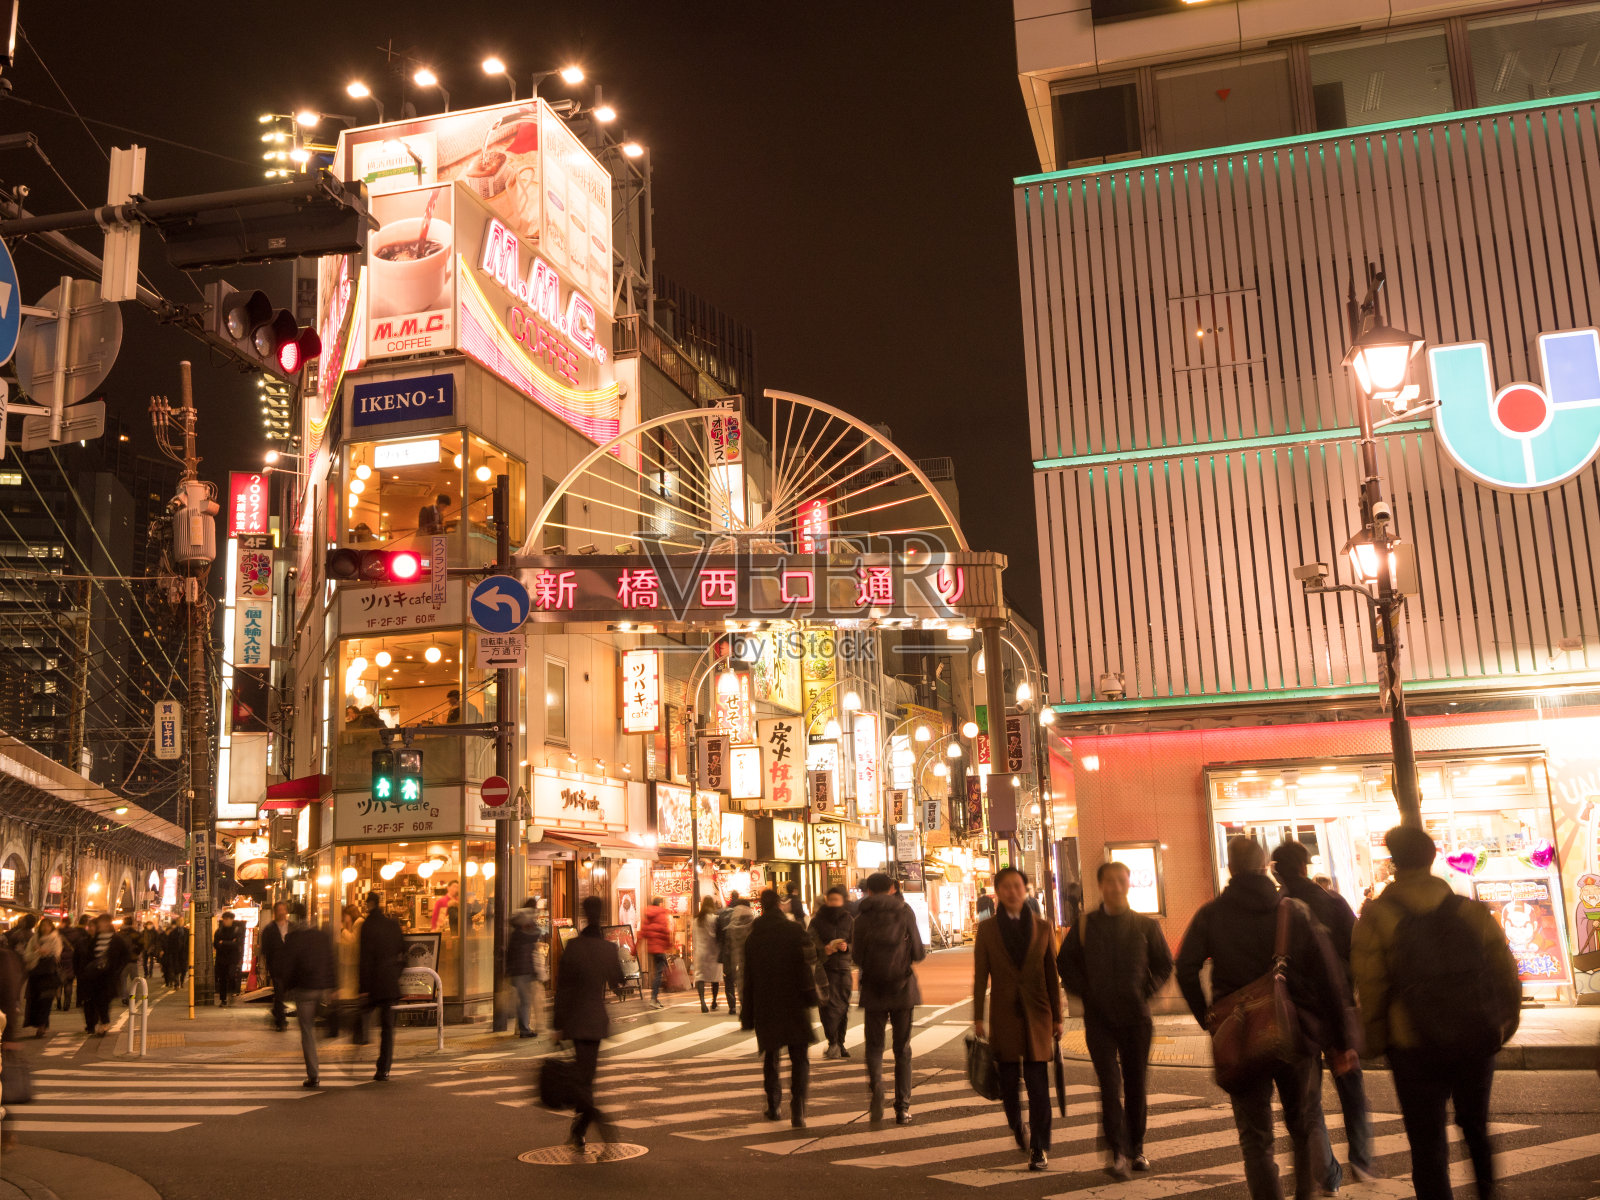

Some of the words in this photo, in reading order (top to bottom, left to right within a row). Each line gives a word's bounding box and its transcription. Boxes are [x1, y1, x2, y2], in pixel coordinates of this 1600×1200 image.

[387, 336, 431, 352] COFFEE
[511, 306, 580, 385] COFFEE
[360, 387, 446, 413] IKENO-1
[712, 418, 725, 460] オアシス
[244, 537, 267, 548] 4F
[242, 552, 254, 596] オアシス
[535, 568, 966, 611] 新橋西口通り
[415, 613, 436, 625] 60席
[243, 609, 262, 665] 個人輸入代行
[481, 637, 521, 647] 自転車を除く
[481, 647, 521, 656] 一方通行
[632, 663, 647, 707] ツバキ
[631, 709, 650, 719] cafe
[163, 721, 173, 747] セキネ
[707, 739, 721, 788] 西口通り
[769, 721, 793, 803] 炭火焼肉
[978, 736, 988, 766] ラーメン
[196, 857, 206, 889] セキネ
